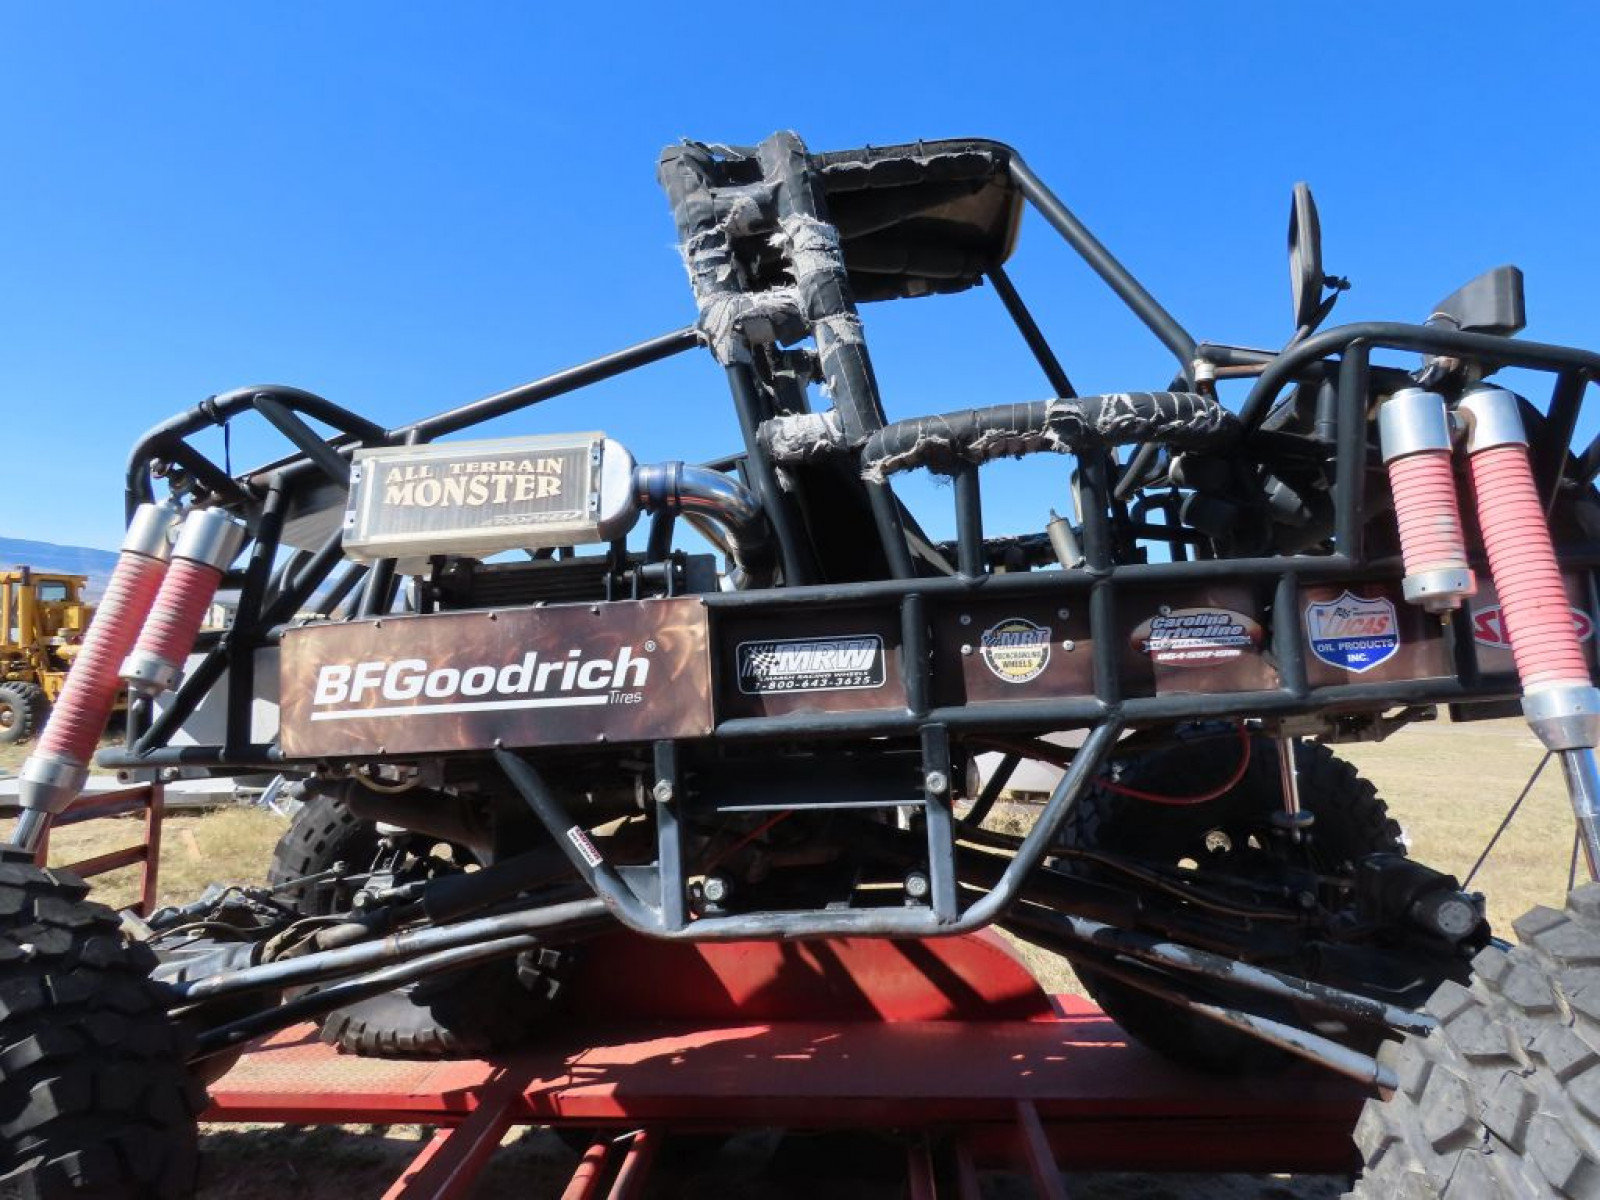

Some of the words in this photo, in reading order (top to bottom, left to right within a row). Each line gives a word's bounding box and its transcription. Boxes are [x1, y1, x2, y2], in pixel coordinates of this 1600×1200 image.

[386, 464, 434, 484] ALL
[449, 457, 565, 475] TERRAIN
[383, 474, 562, 508] MONSTER
[1151, 613, 1230, 628] Carolina
[1321, 614, 1390, 636] LUCAS
[1000, 628, 1048, 647] MRT
[1150, 624, 1246, 640] Driveline
[1316, 643, 1335, 652] OIL
[1338, 638, 1395, 651] PRODUCTS
[775, 639, 878, 674] MRW
[1346, 652, 1370, 663] INC.
[313, 646, 651, 706] BFGoodrich
[608, 690, 643, 705] Tires
